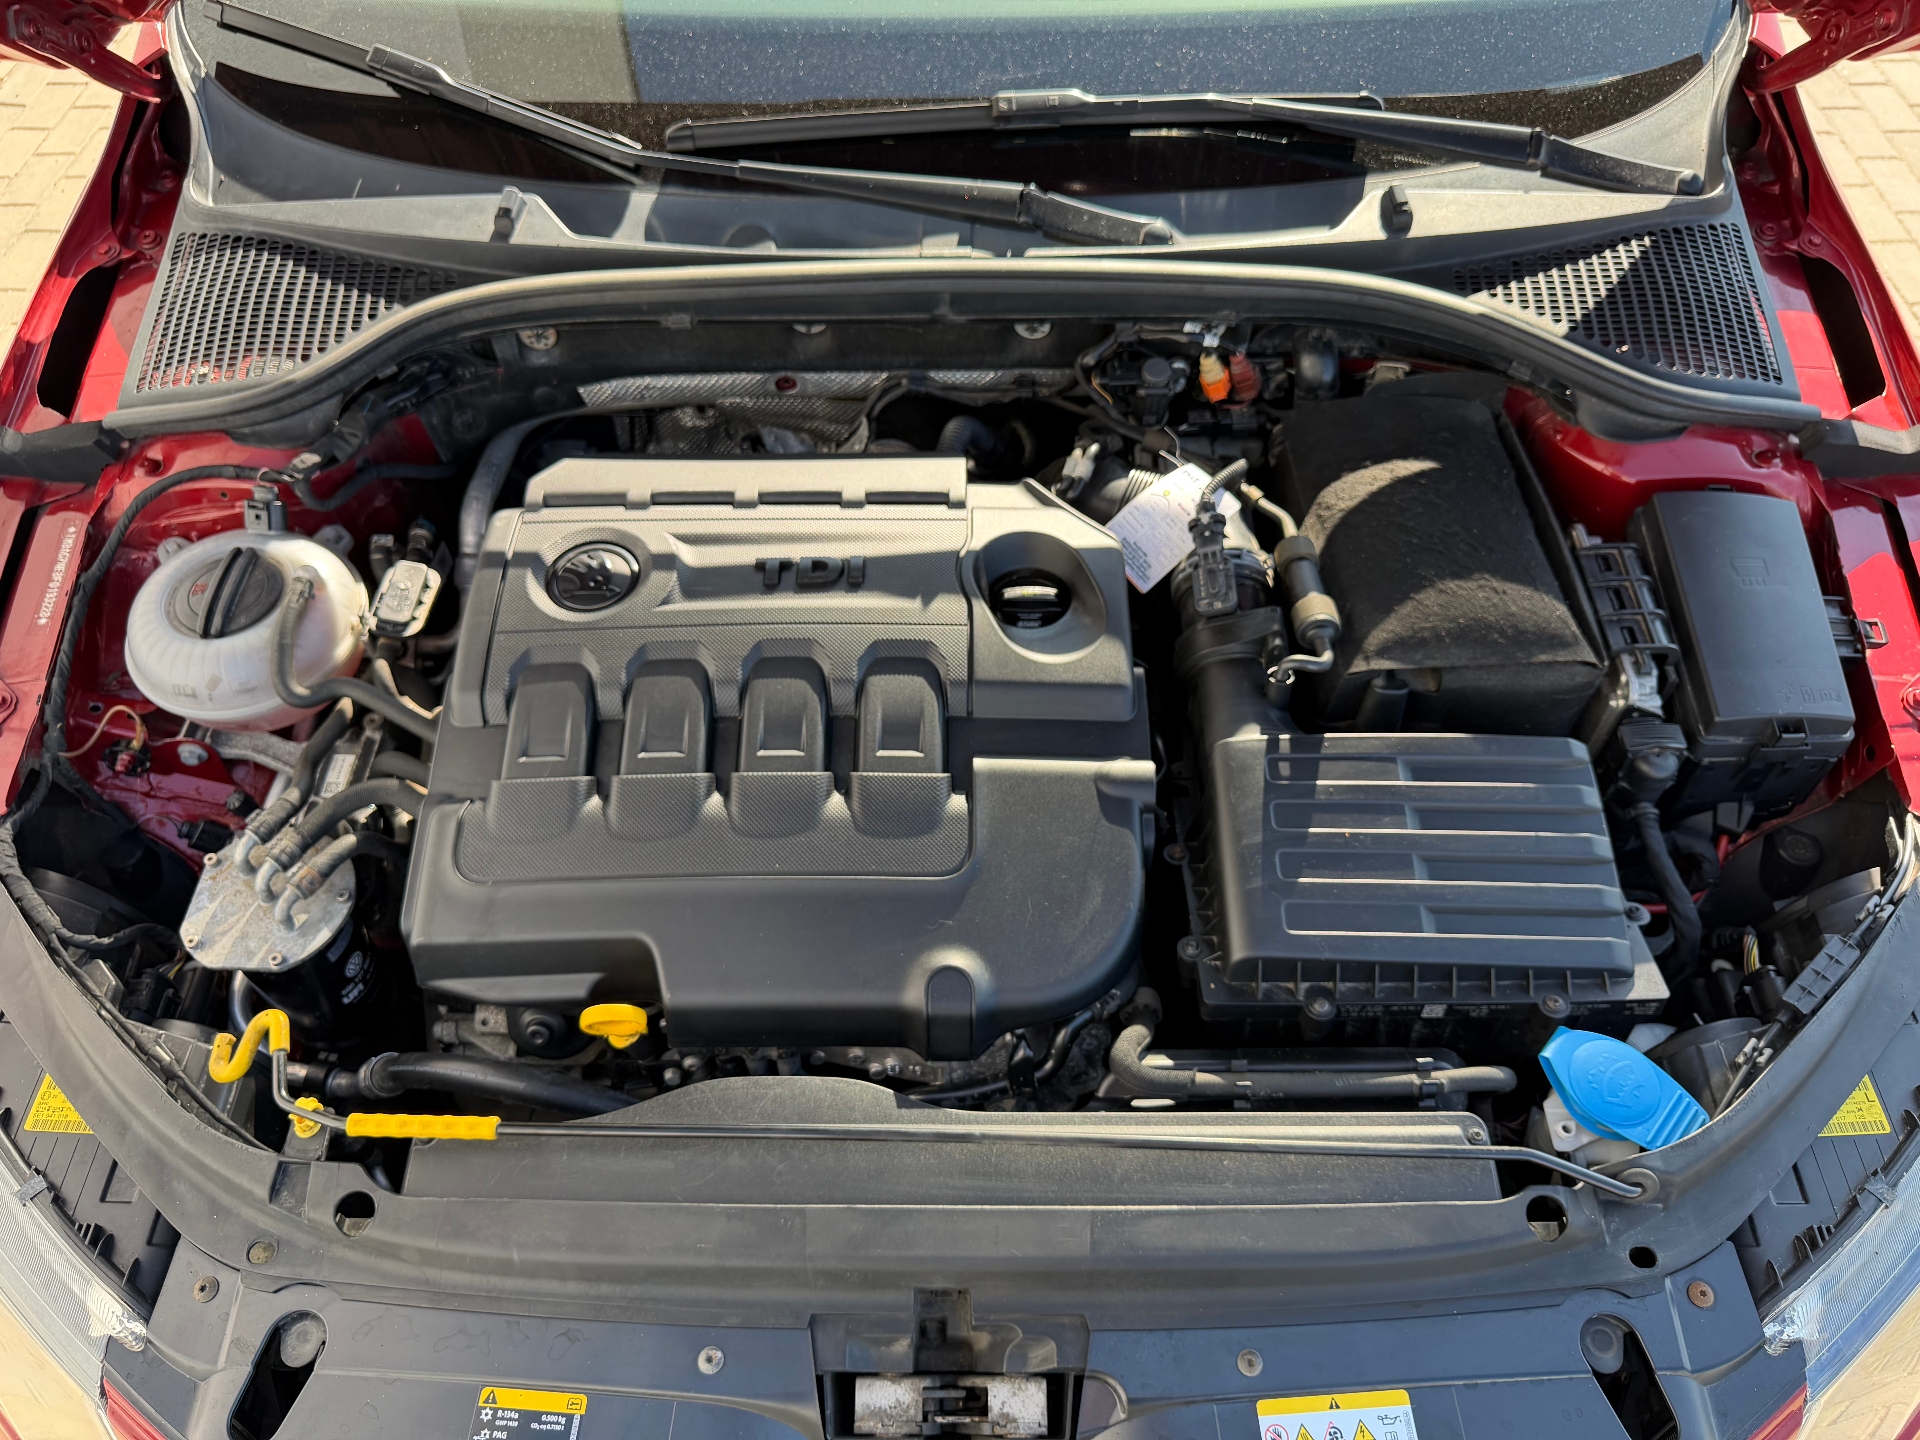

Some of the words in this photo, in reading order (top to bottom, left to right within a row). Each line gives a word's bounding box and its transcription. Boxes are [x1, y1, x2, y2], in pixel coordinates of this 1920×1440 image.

[755, 556, 865, 588] TDI
[1864, 1092, 1875, 1102] L
[497, 1410, 519, 1419] R-134a
[558, 1415, 566, 1424] kg
[492, 1430, 508, 1439] PAG
